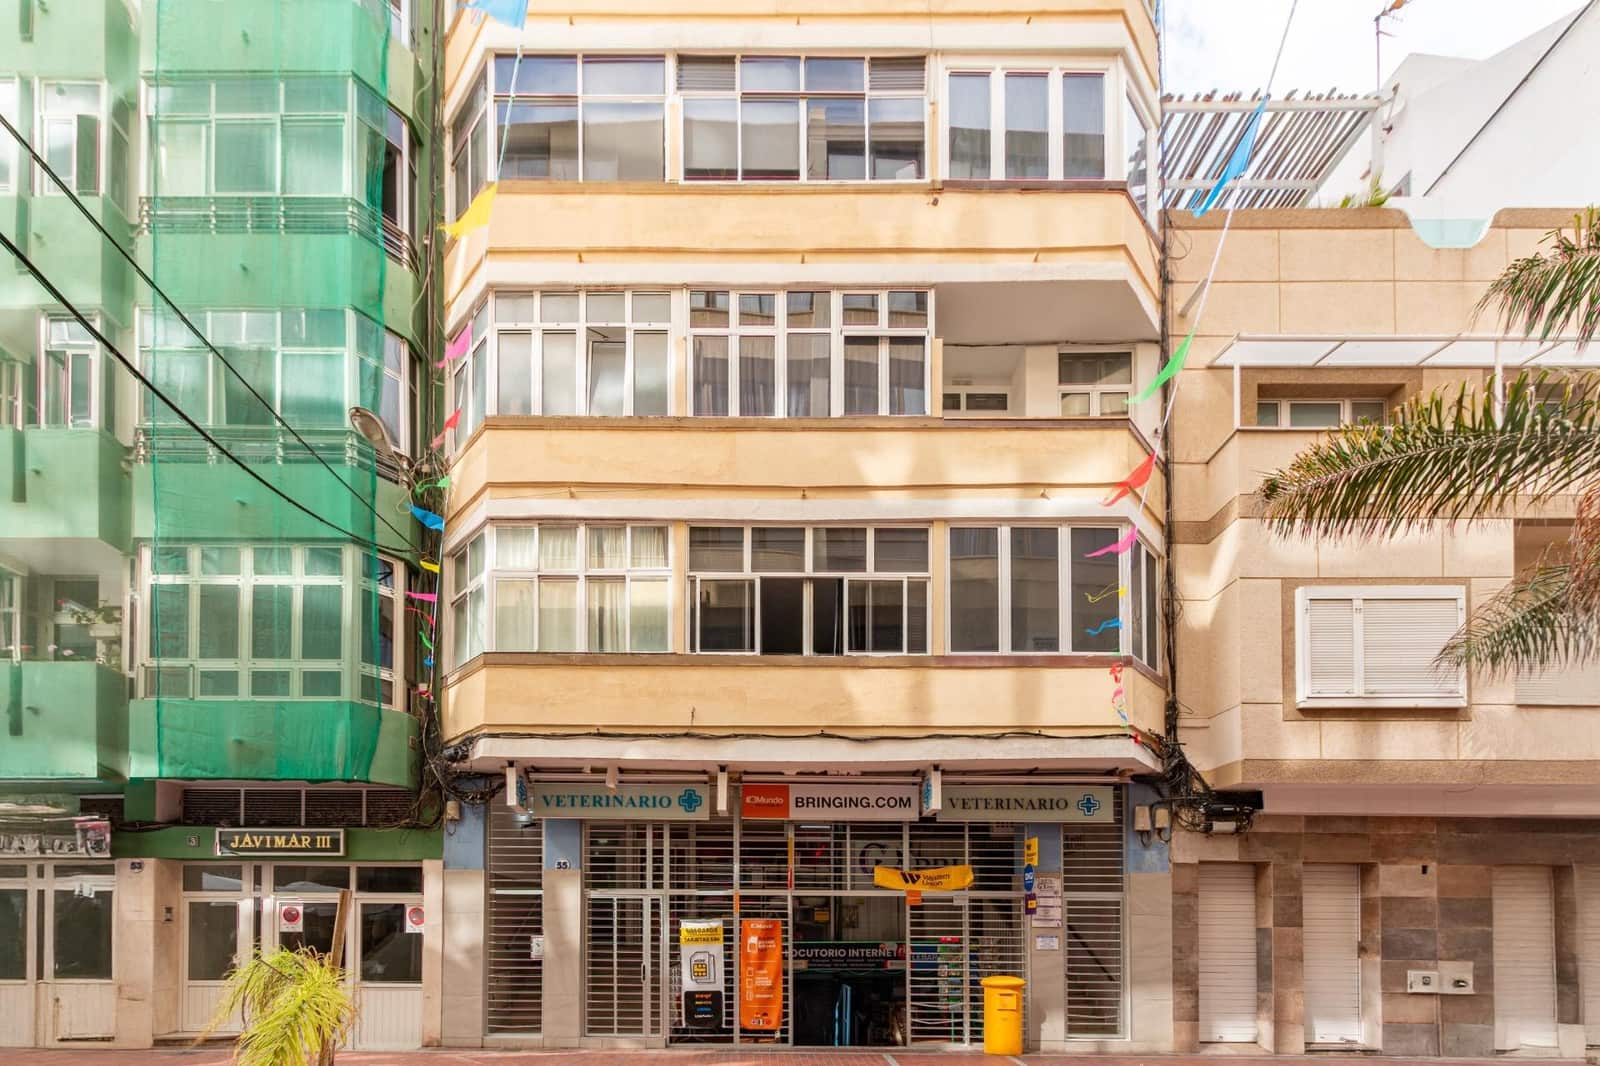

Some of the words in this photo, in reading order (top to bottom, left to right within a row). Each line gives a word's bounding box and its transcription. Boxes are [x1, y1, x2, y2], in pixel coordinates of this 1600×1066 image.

[542, 794, 672, 808] VETERINARIO
[795, 796, 912, 809] BRINGING.COM
[949, 797, 1069, 810] VETERINARIO
[230, 832, 311, 849] JAVIMAR
[316, 835, 331, 848] III
